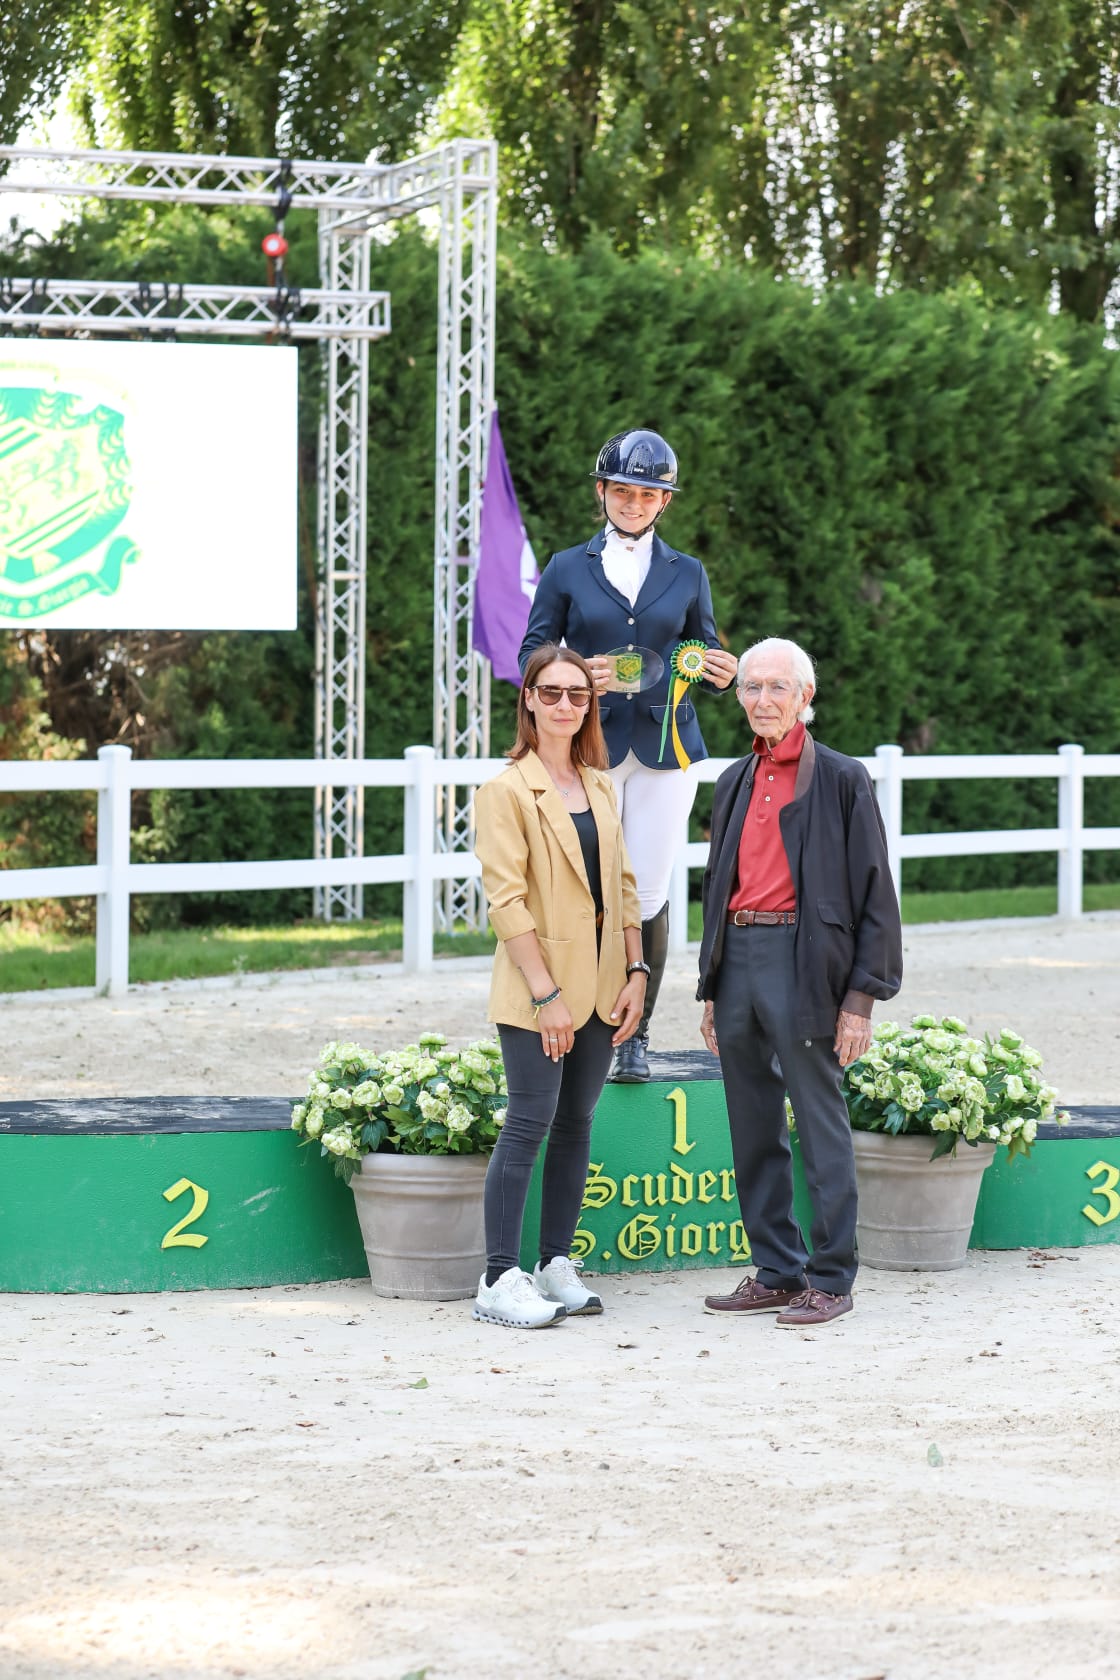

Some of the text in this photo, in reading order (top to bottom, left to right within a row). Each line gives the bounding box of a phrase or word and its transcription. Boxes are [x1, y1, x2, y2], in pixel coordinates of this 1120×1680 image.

[665, 1087, 696, 1156] 1
[161, 1177, 209, 1250] 2
[1082, 1160, 1120, 1227] 3
